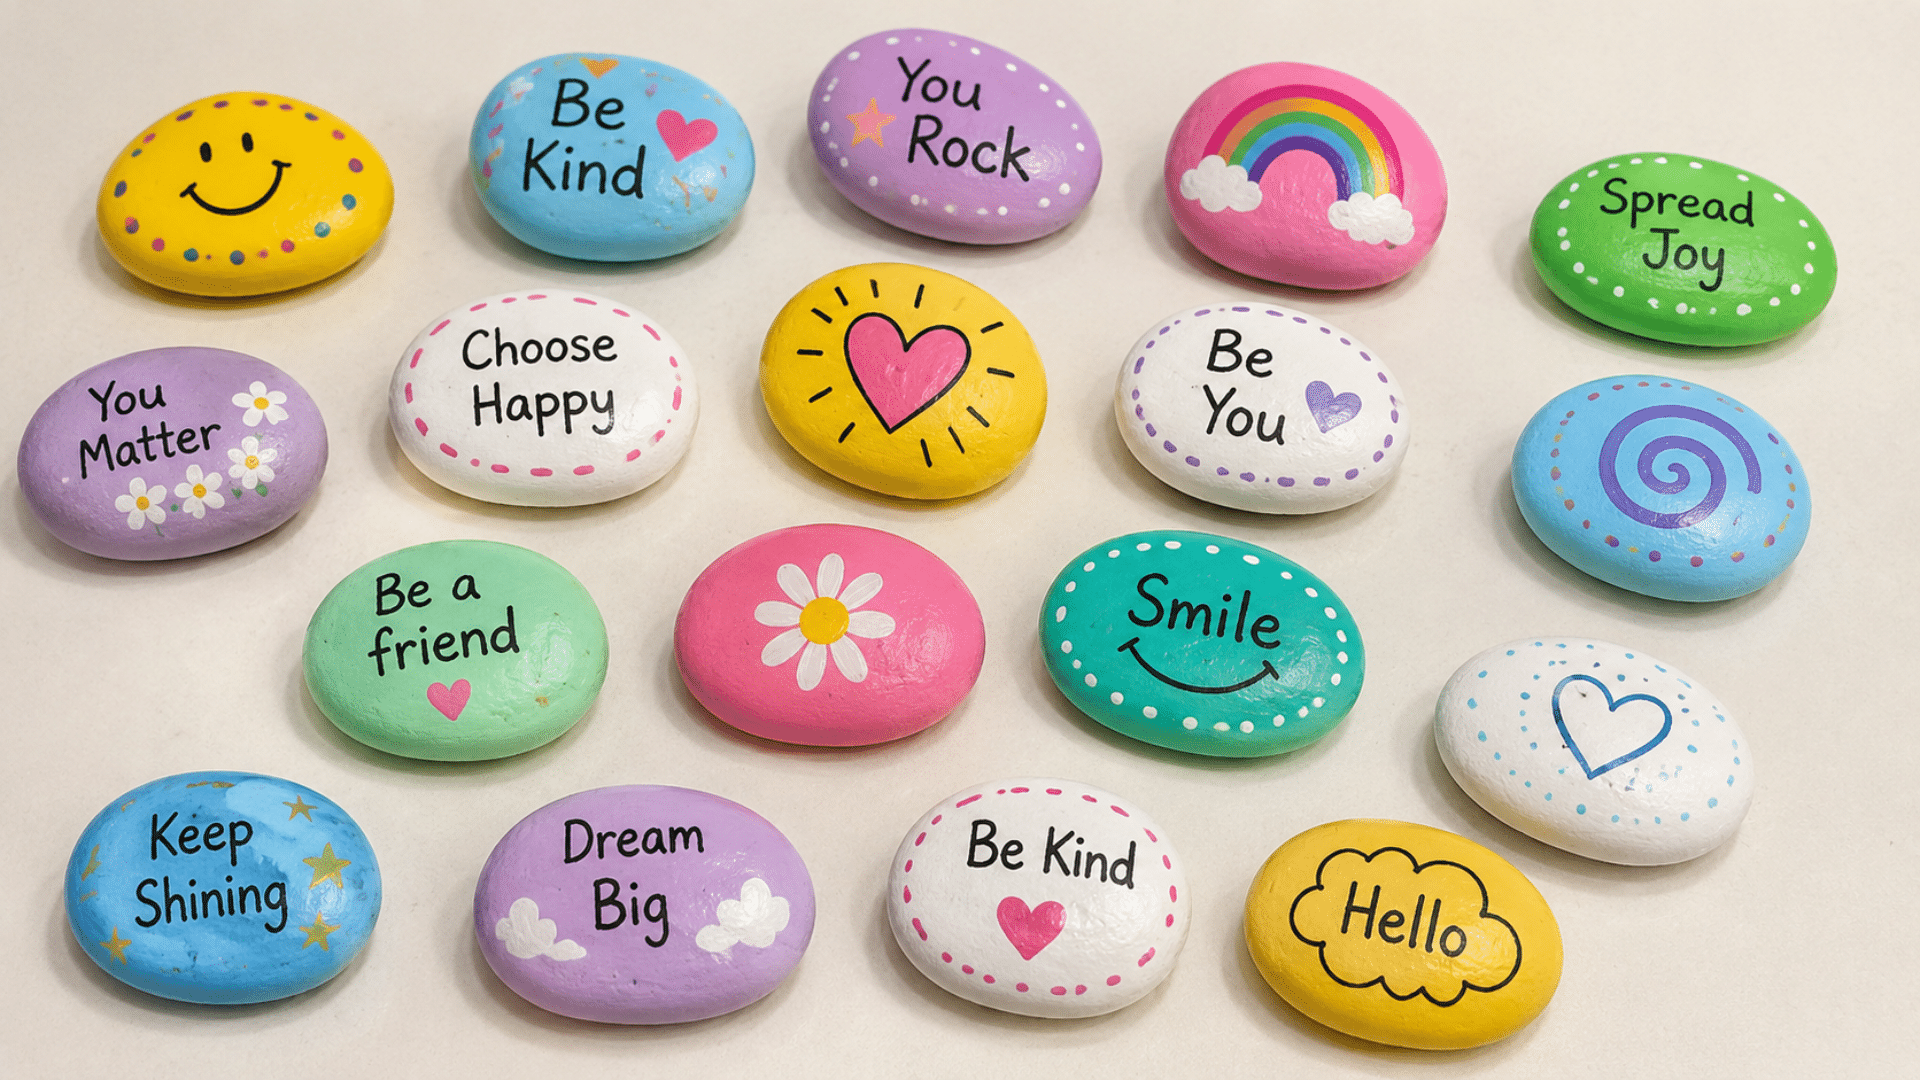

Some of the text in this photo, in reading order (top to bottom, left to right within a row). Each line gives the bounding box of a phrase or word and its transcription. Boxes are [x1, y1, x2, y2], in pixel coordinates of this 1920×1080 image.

[551, 78, 625, 131] Be
[897, 56, 981, 111] You
[522, 137, 646, 200] Kind
[907, 114, 1031, 182] Rock
[1599, 177, 1755, 229] Spread
[1642, 227, 1725, 293] Joy
[462, 326, 618, 370] Choose
[1206, 328, 1273, 378] Be
[87, 380, 167, 422] You
[473, 381, 614, 437] Happy
[1202, 384, 1285, 446] You
[79, 422, 222, 480] Matter
[375, 572, 481, 614] Be a
[1126, 572, 1281, 650] Smile
[367, 605, 520, 677] friend
[150, 811, 254, 865] Keep
[563, 818, 705, 863] Dream
[966, 819, 1136, 890] Be Kind
[134, 875, 288, 934] Shining
[593, 877, 670, 948] Big
[1341, 880, 1467, 957] Hello
